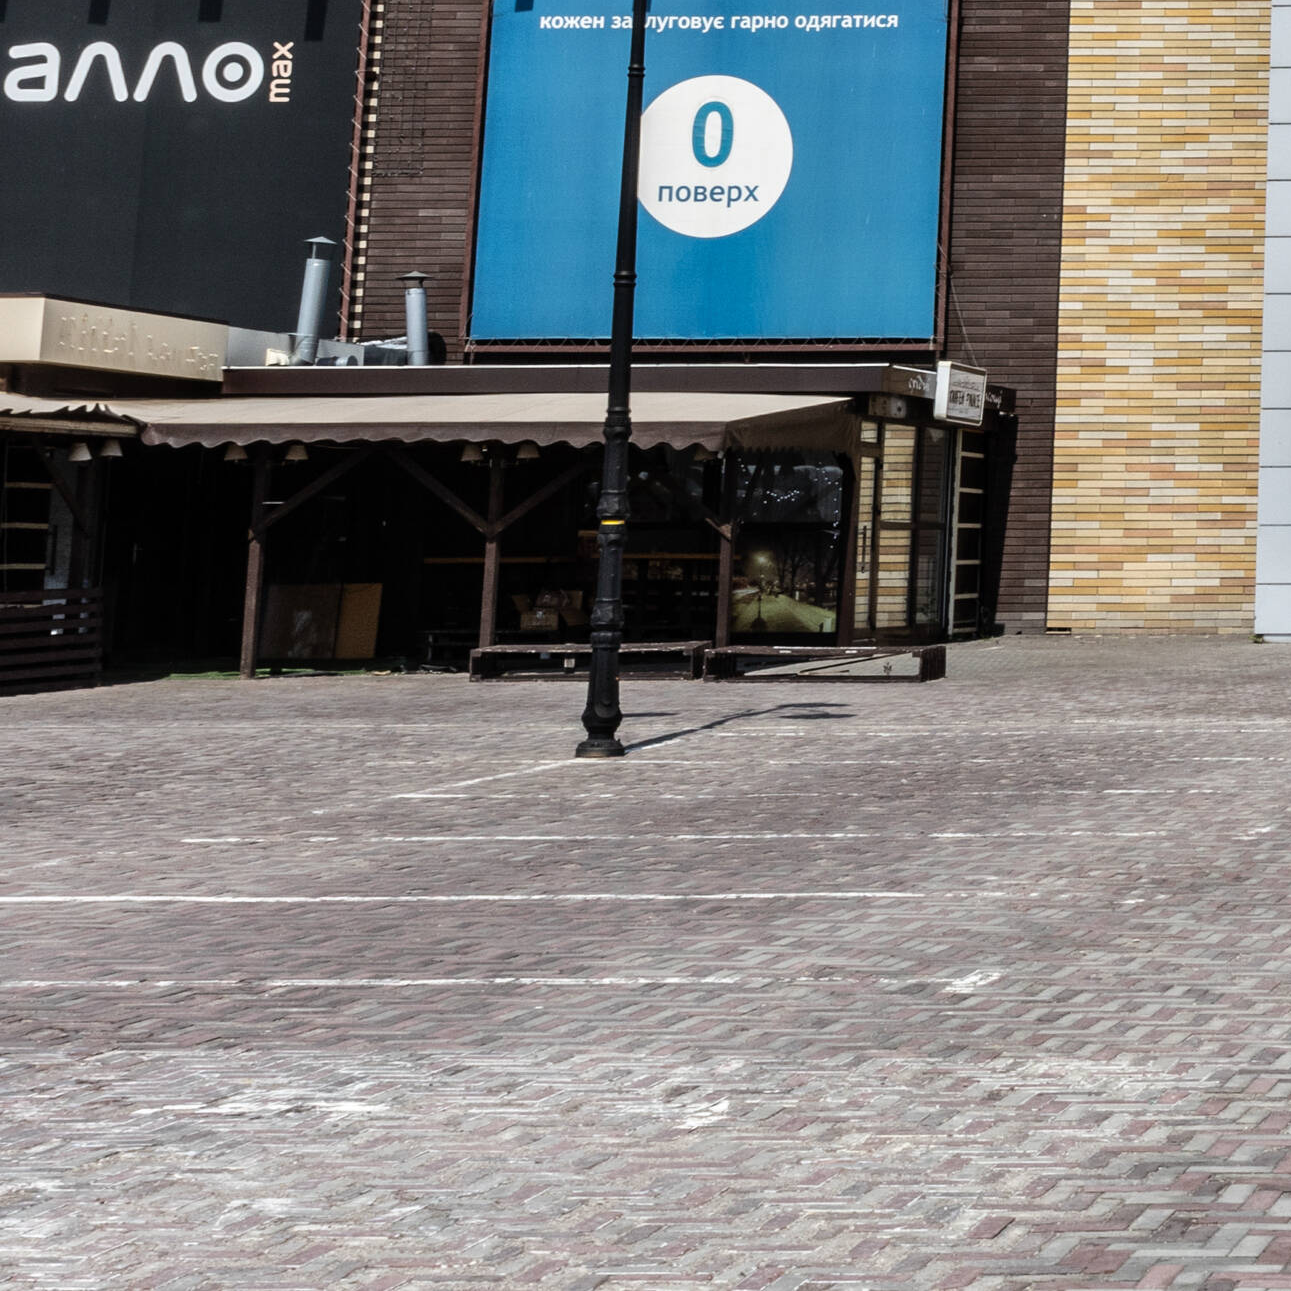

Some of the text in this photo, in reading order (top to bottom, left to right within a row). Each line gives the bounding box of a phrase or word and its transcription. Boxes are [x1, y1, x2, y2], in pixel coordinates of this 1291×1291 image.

[540, 14, 898, 33] кожен залуговує гарно одягатися
[268, 41, 294, 103] max
[692, 101, 734, 168] 0
[658, 184, 760, 208] поверх
